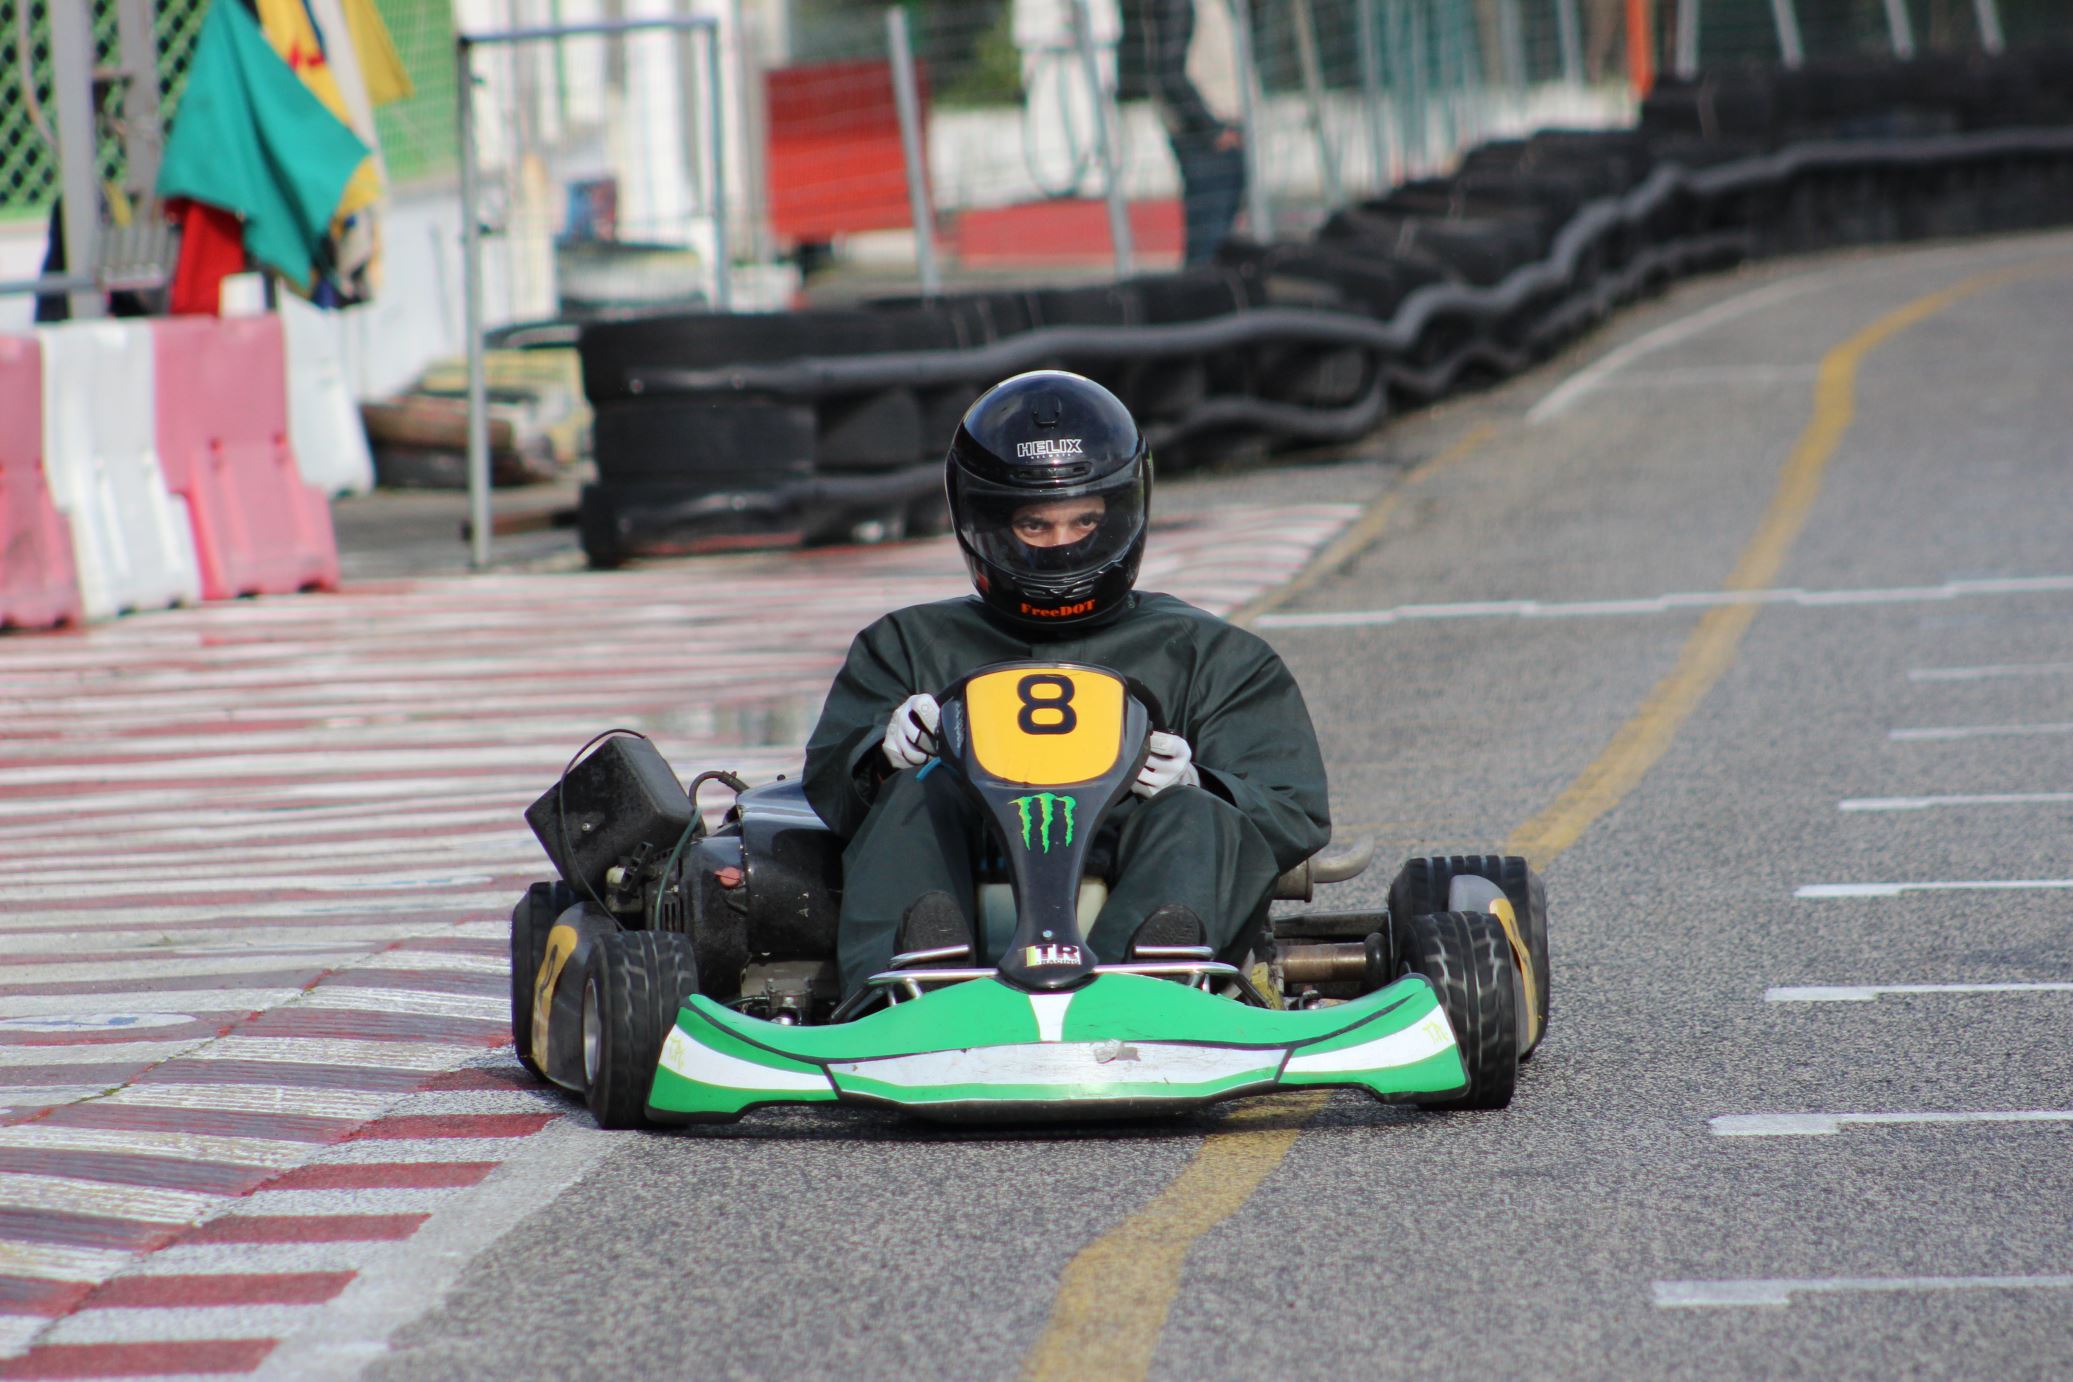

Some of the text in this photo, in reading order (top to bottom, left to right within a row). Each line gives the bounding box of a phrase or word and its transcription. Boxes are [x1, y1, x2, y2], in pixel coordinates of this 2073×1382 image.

[1017, 439, 1083, 457] HELIX
[1021, 599, 1095, 617] FreeDOT
[1017, 674, 1077, 735] 8
